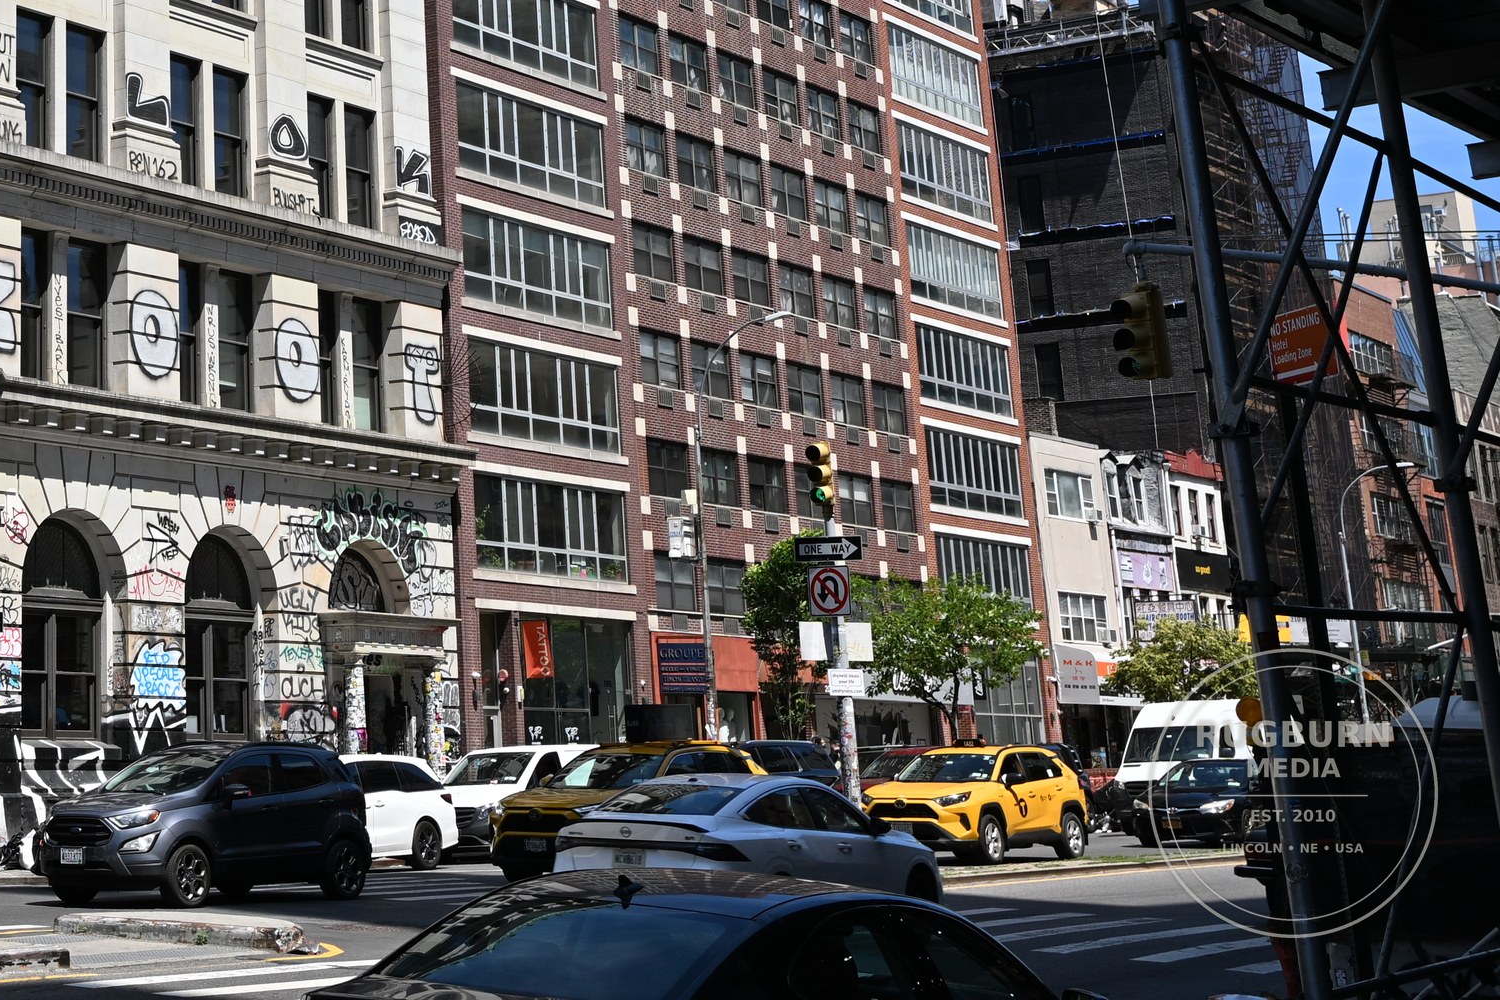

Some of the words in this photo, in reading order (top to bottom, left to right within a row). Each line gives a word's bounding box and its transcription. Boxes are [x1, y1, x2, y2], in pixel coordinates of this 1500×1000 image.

[1283, 312, 1320, 333] STANDING
[1272, 338, 1288, 351] Hotel
[1274, 351, 1297, 365] Loading
[1298, 348, 1312, 359] Zone
[804, 545, 822, 554] ONE
[831, 544, 851, 554] WAY
[660, 648, 704, 659] GROUPE
